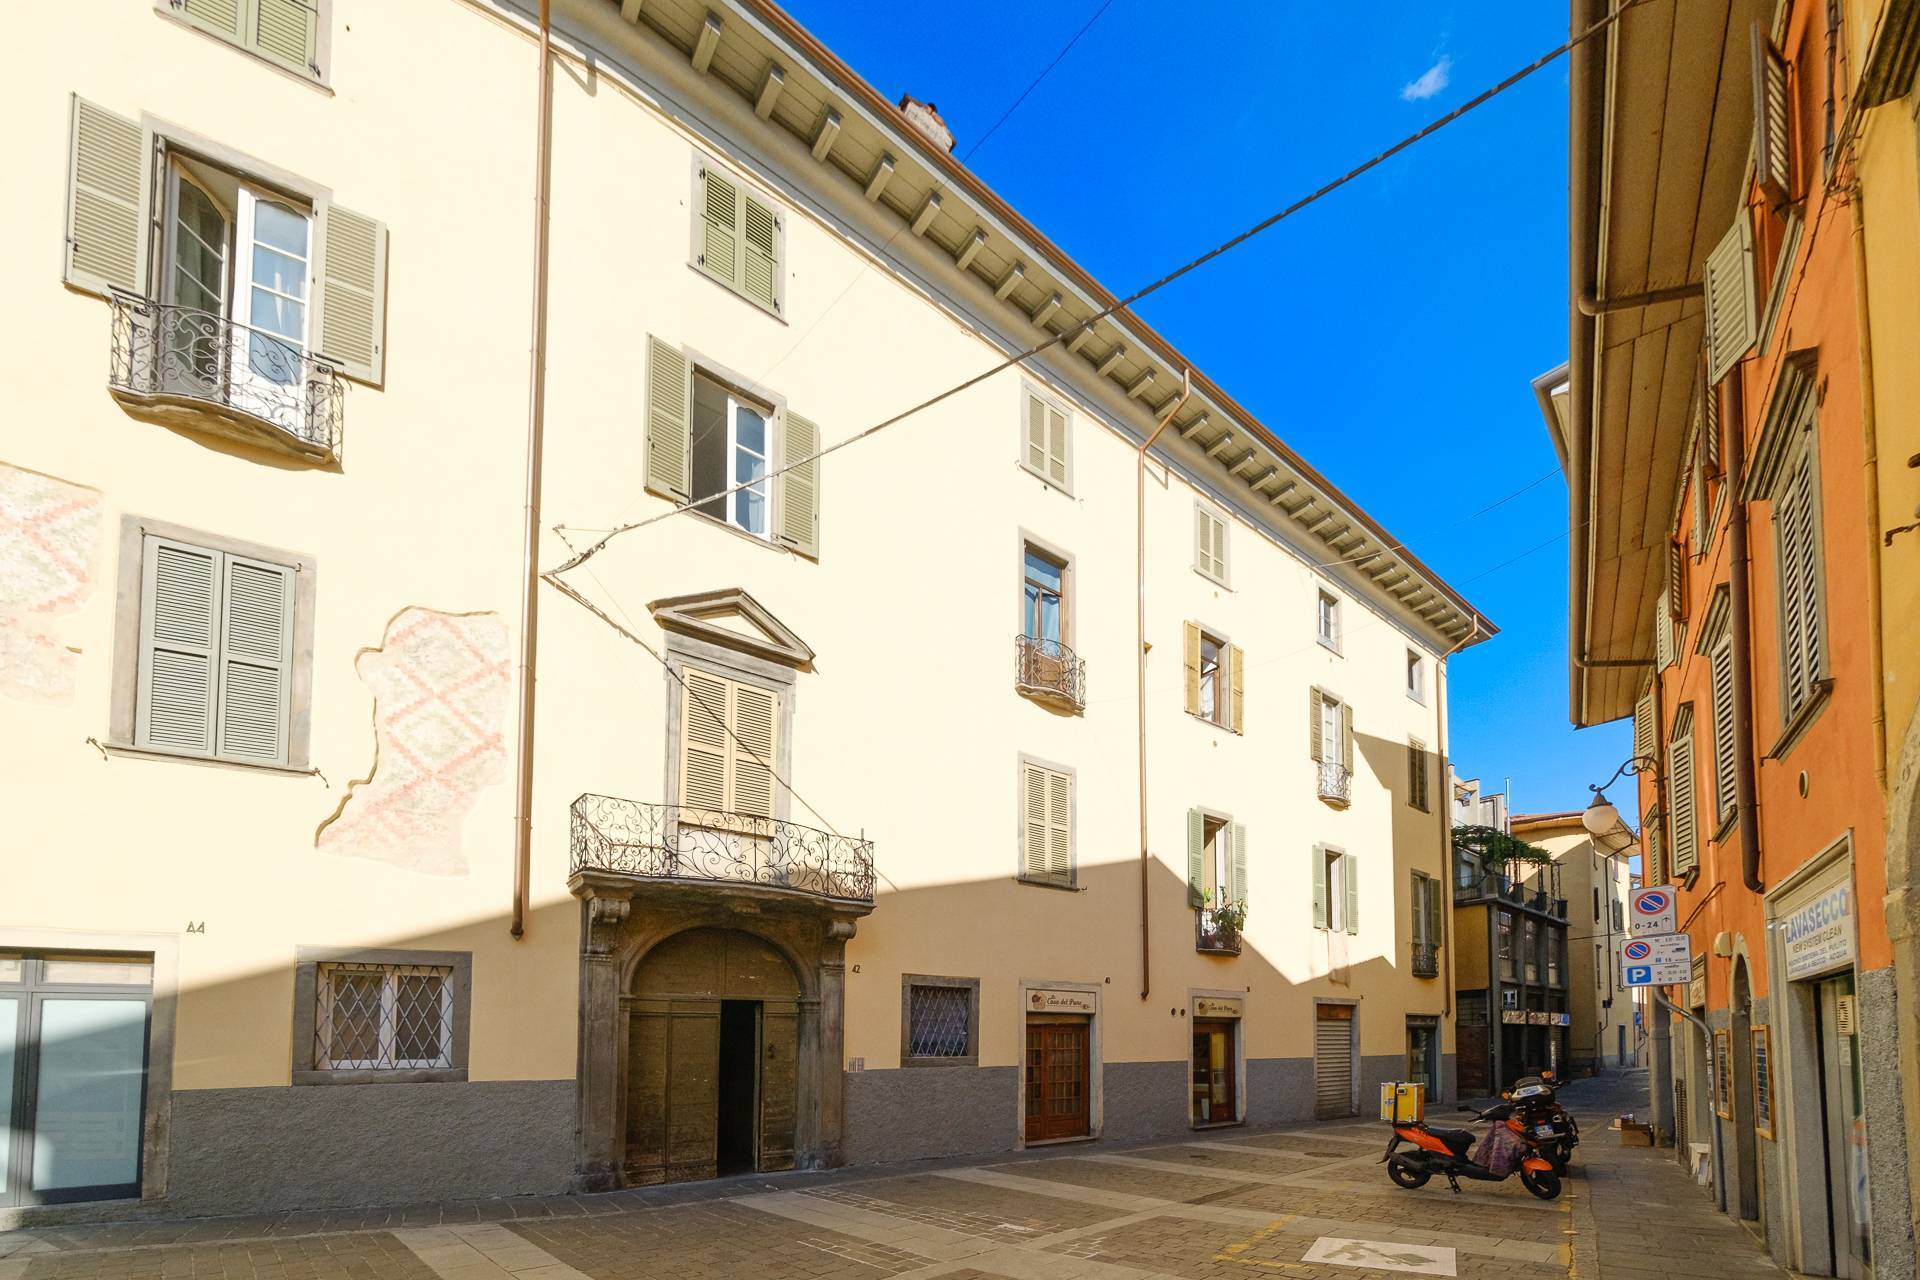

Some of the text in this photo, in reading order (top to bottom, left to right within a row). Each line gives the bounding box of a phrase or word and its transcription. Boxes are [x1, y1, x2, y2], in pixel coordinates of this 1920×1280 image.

[1786, 888, 1849, 943] LAVASECCO
[186, 921, 205, 934] 44
[1823, 925, 1842, 942] CLEAN
[1632, 969, 1646, 982] P
